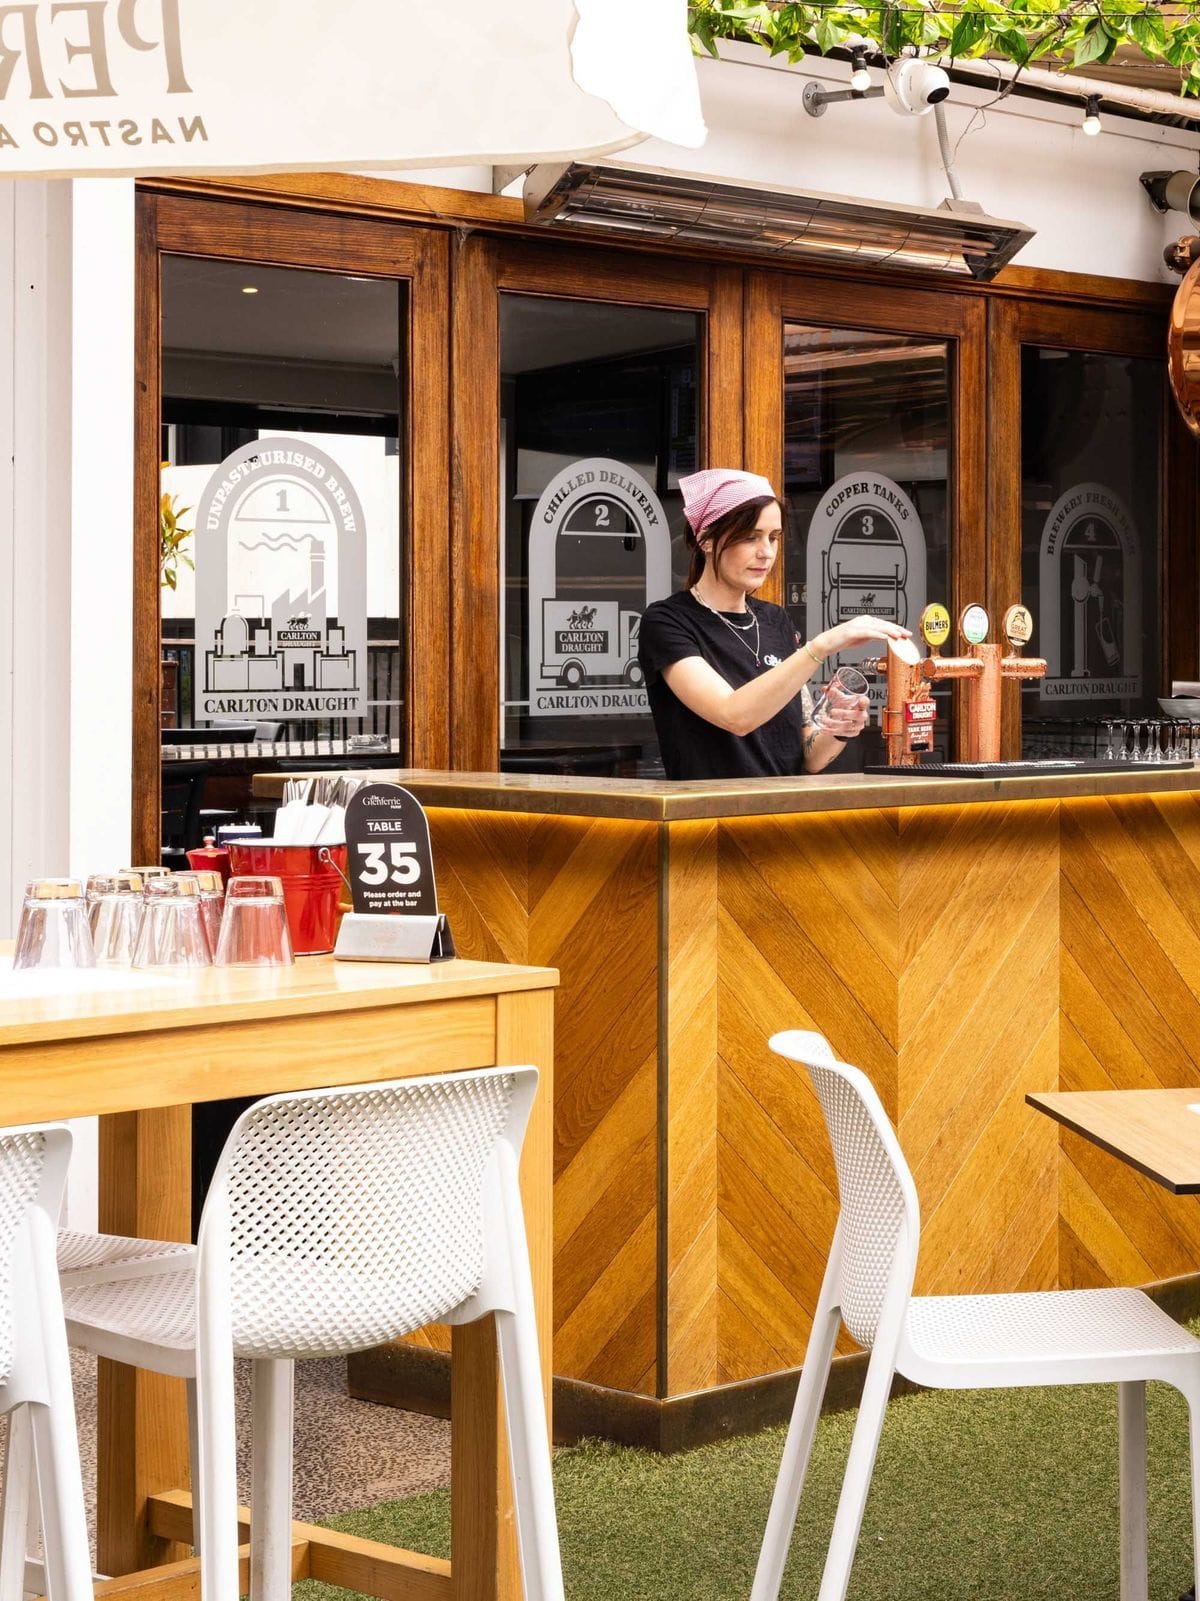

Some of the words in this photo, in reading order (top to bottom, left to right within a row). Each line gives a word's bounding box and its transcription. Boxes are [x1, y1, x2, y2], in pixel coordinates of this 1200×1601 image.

[206, 450, 326, 530] UNPASTEURISED
[324, 476, 357, 532] BREW
[543, 471, 595, 524] CHILLED
[599, 470, 659, 526] DELIVERY
[276, 489, 290, 512] 1
[826, 482, 870, 517] COPPER
[873, 483, 910, 520] TANKS
[594, 504, 610, 526] 2
[1047, 493, 1083, 555] BREWERY
[862, 515, 875, 535] 3
[1084, 522, 1097, 542] 4
[926, 620, 949, 631] BULMERS
[280, 632, 318, 640] CARLTON
[559, 632, 604, 643] CARLTON
[561, 643, 603, 653] DRAUGHT
[1045, 683, 1088, 695] CARLTON
[1090, 682, 1137, 694] DRAUGHT
[204, 698, 279, 713] CARLTON
[282, 697, 359, 712] DRAUGHT
[537, 695, 599, 709] CARLTON
[602, 694, 650, 707] DRAUG
[910, 702, 936, 713] CARLTON
[367, 822, 402, 832] TABLE
[357, 842, 421, 886] 35
